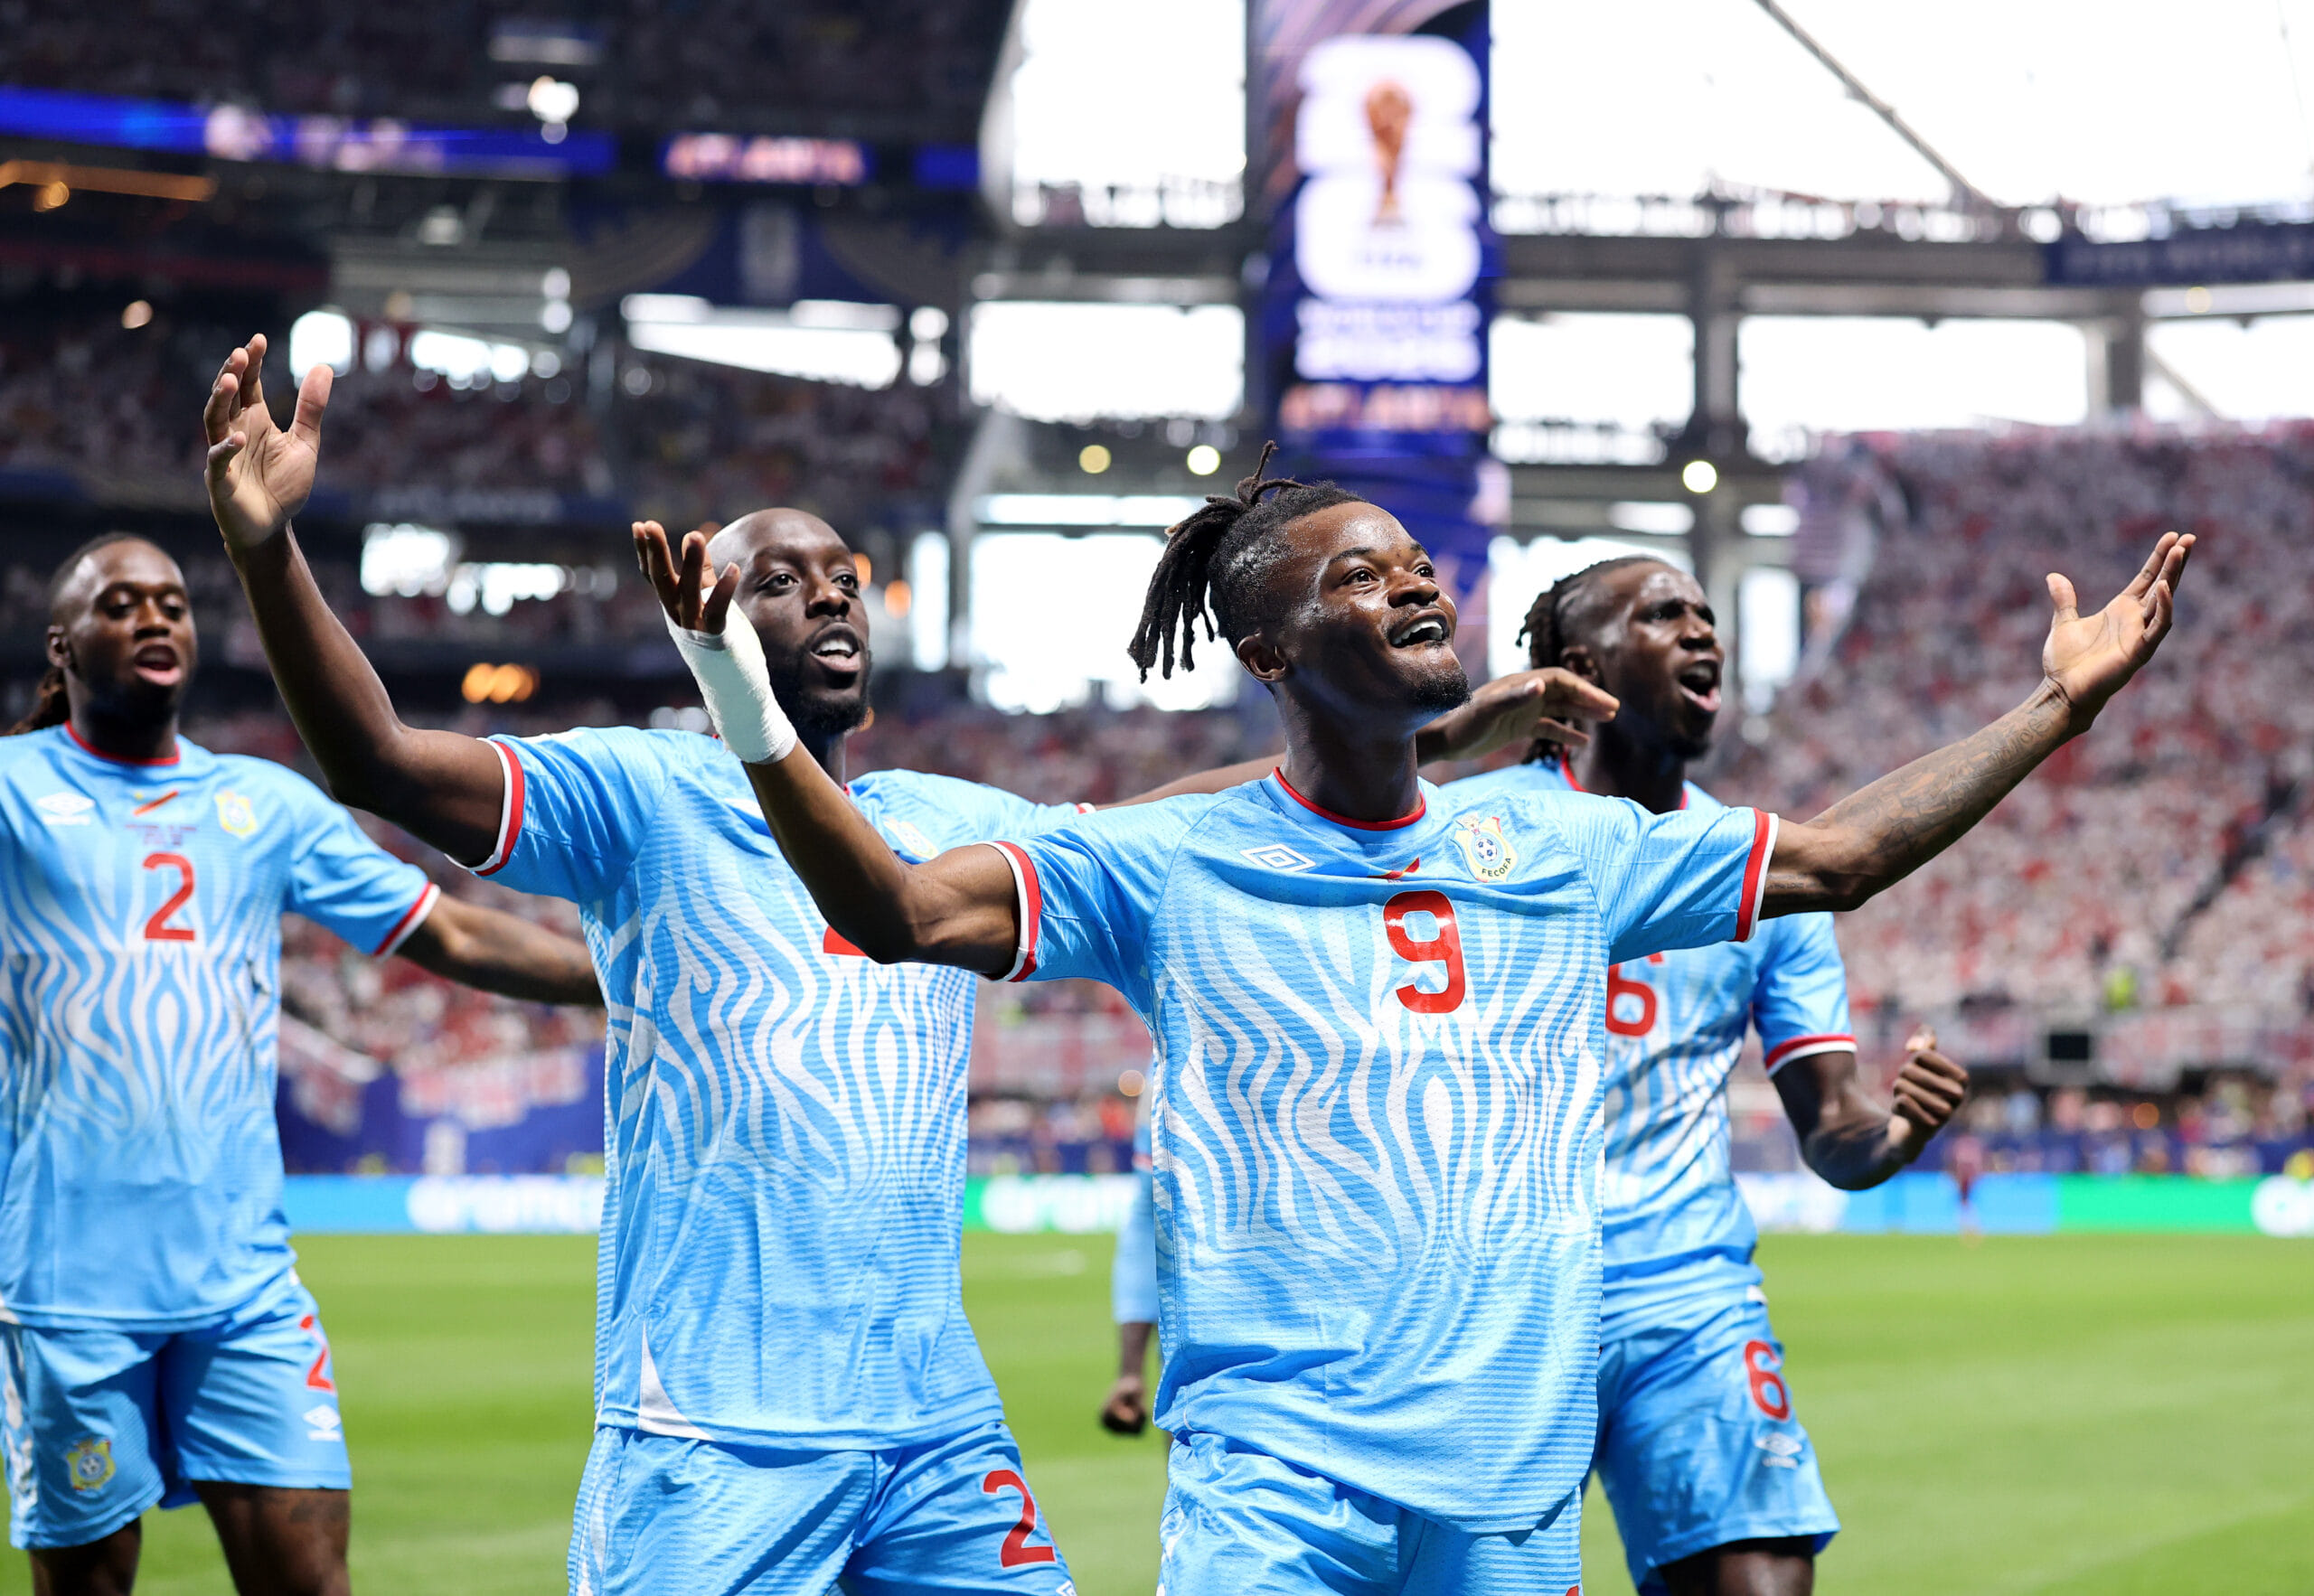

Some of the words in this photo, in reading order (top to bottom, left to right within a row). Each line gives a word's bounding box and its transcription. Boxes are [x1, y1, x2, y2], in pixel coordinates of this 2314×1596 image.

[143, 852, 195, 941] 2
[1482, 857, 1512, 878] FECOFA
[1383, 890, 1465, 1013] 9
[1605, 952, 1663, 1037] 6
[1745, 1340, 1790, 1422] 6
